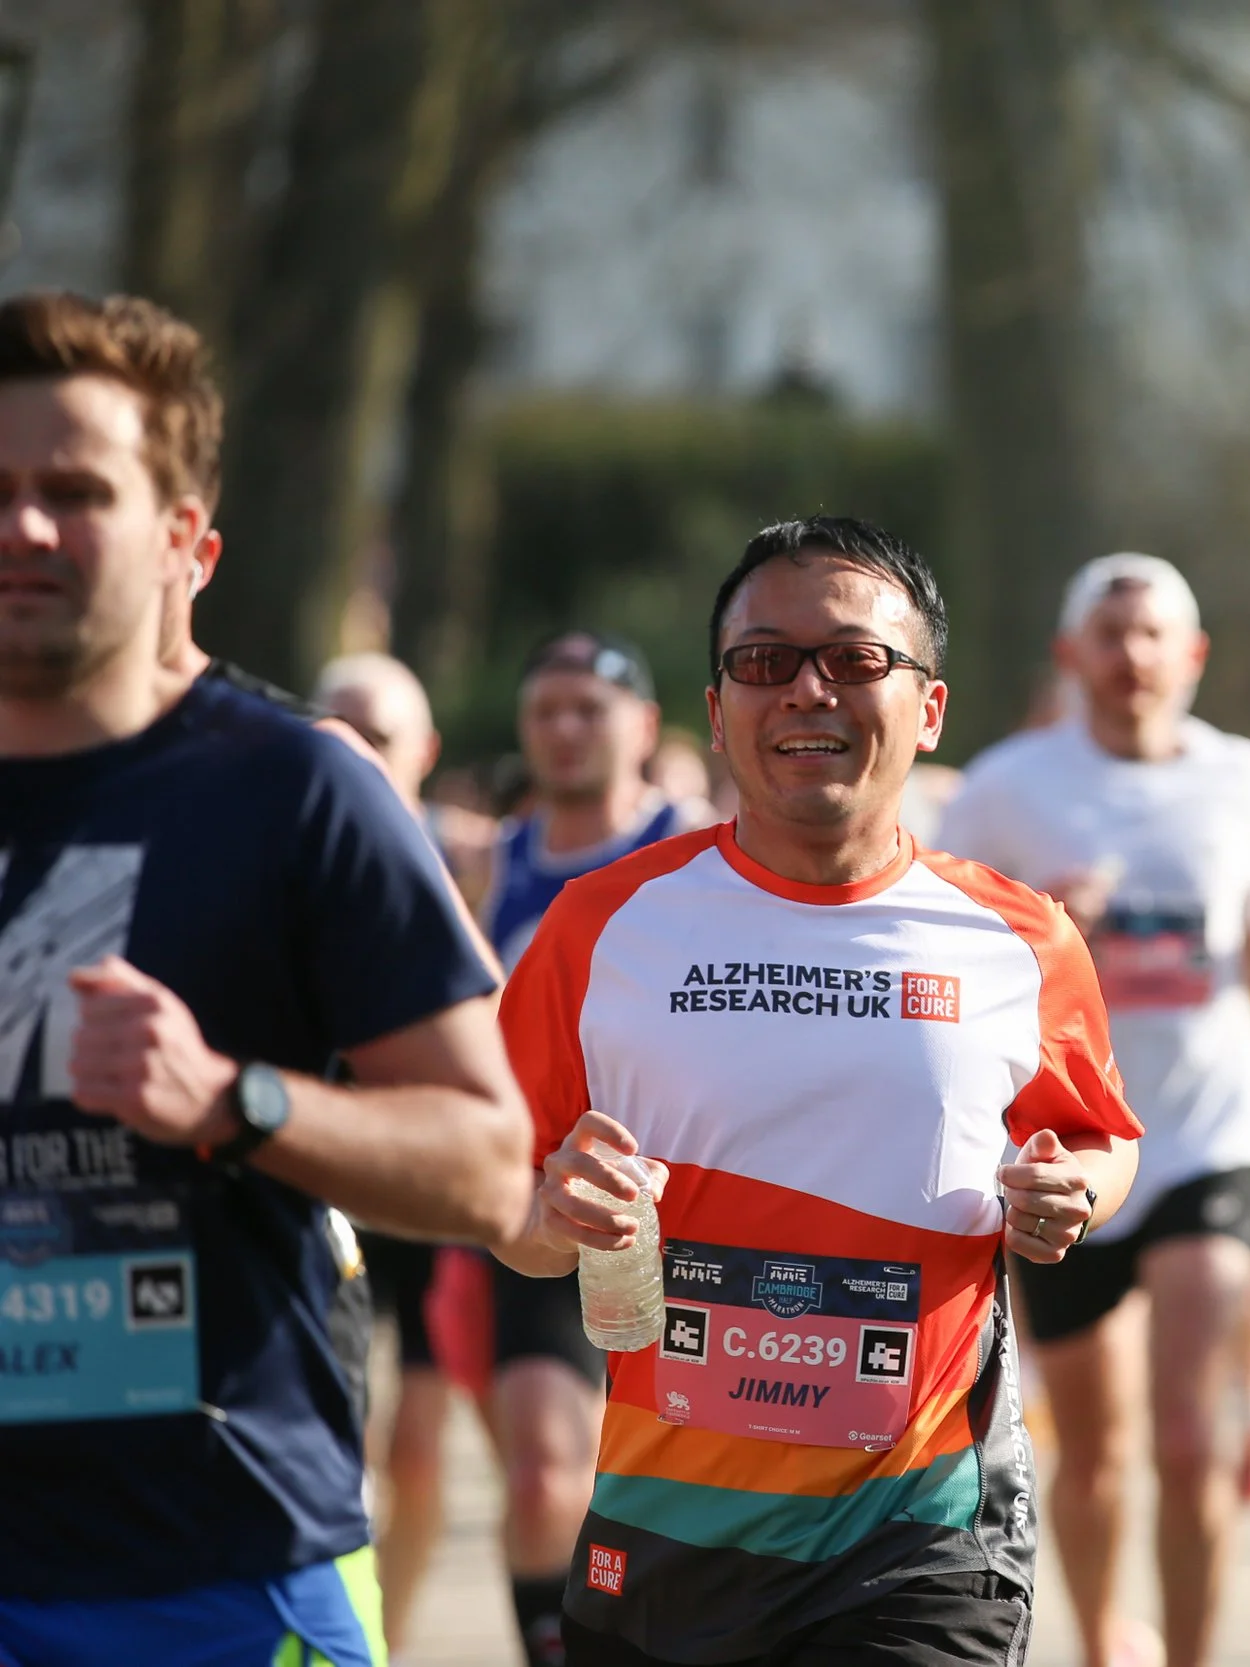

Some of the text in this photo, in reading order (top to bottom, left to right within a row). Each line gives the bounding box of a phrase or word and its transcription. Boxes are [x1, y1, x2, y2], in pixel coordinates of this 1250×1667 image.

[683, 963, 891, 992] ALZHEIMER'S
[907, 978, 955, 998] FOR A
[670, 989, 890, 1018] RESEARCH UK
[907, 995, 955, 1018] CURE
[758, 1282, 818, 1300] CAMBRIDGE
[842, 1279, 886, 1288] ALZHEIMER'S
[849, 1285, 886, 1293] RESEARCH
[888, 1291, 905, 1299] CURE
[768, 1298, 804, 1314] MARATHON
[722, 1326, 847, 1367] C.6239
[728, 1377, 831, 1408] JIMMY
[859, 1432, 892, 1442] Gearset
[1013, 1491, 1031, 1532] UK
[592, 1549, 622, 1572] FOR A
[591, 1567, 621, 1590] CURE
